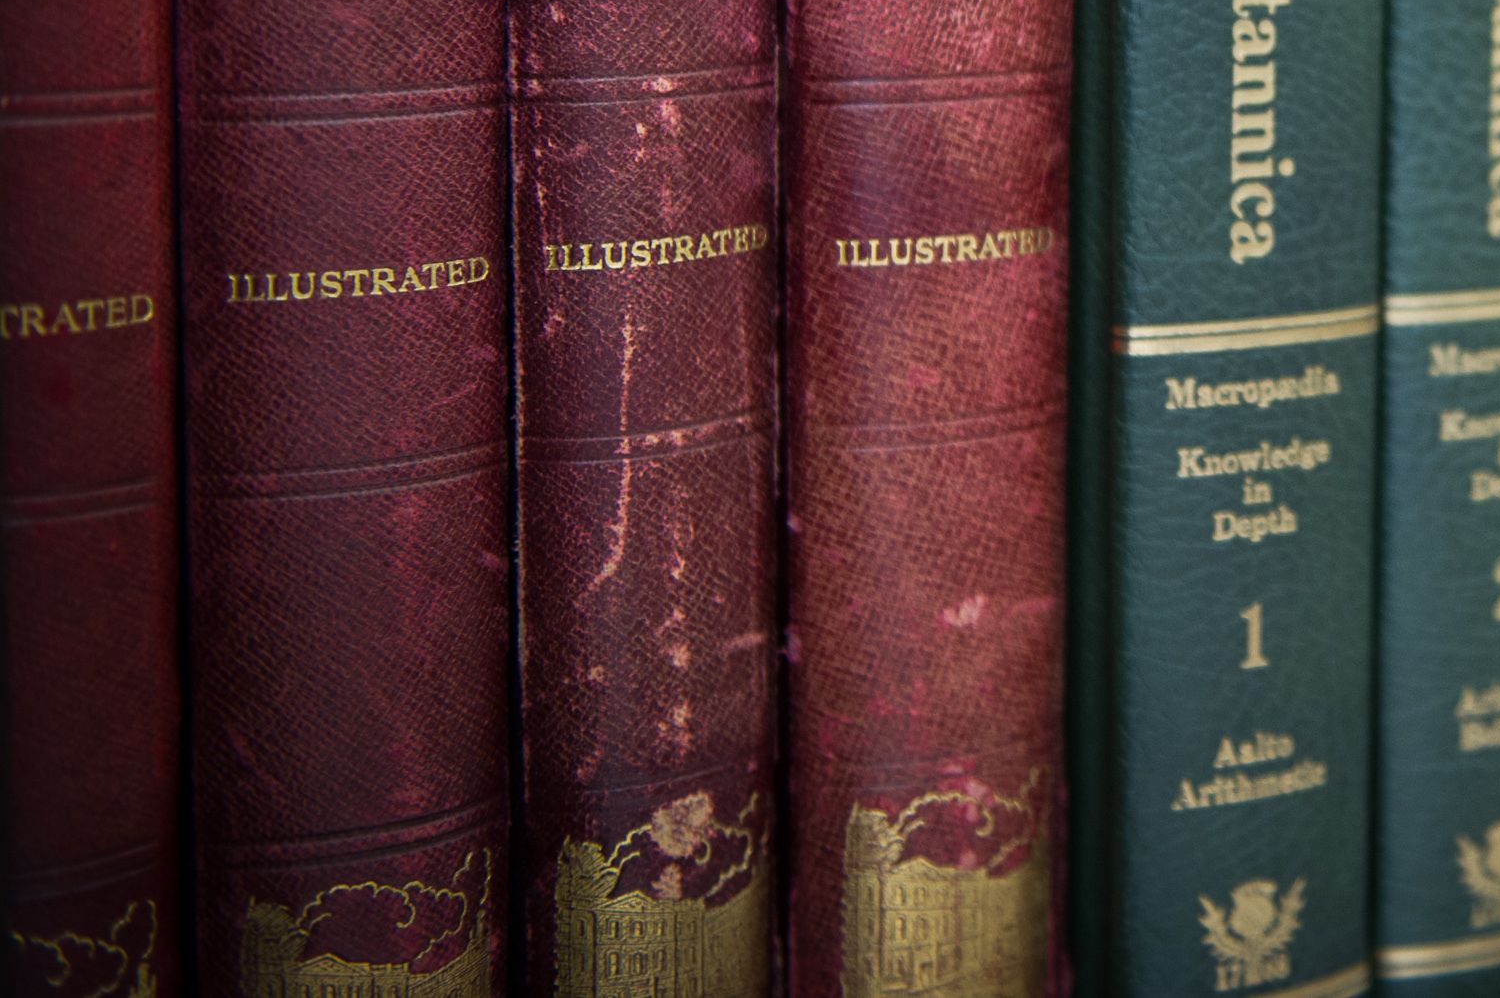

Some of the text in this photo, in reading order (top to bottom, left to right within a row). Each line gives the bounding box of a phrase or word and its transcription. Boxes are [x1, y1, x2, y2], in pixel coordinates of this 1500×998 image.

[545, 225, 768, 270] ILLUSTRATED
[837, 227, 1053, 266] ILLUSTRATED
[228, 256, 490, 302] ILLUSTRATED
[1178, 437, 1331, 479] Knowledge
[1243, 478, 1272, 504] in
[1213, 505, 1297, 542] Depth
[1241, 603, 1268, 669] 1
